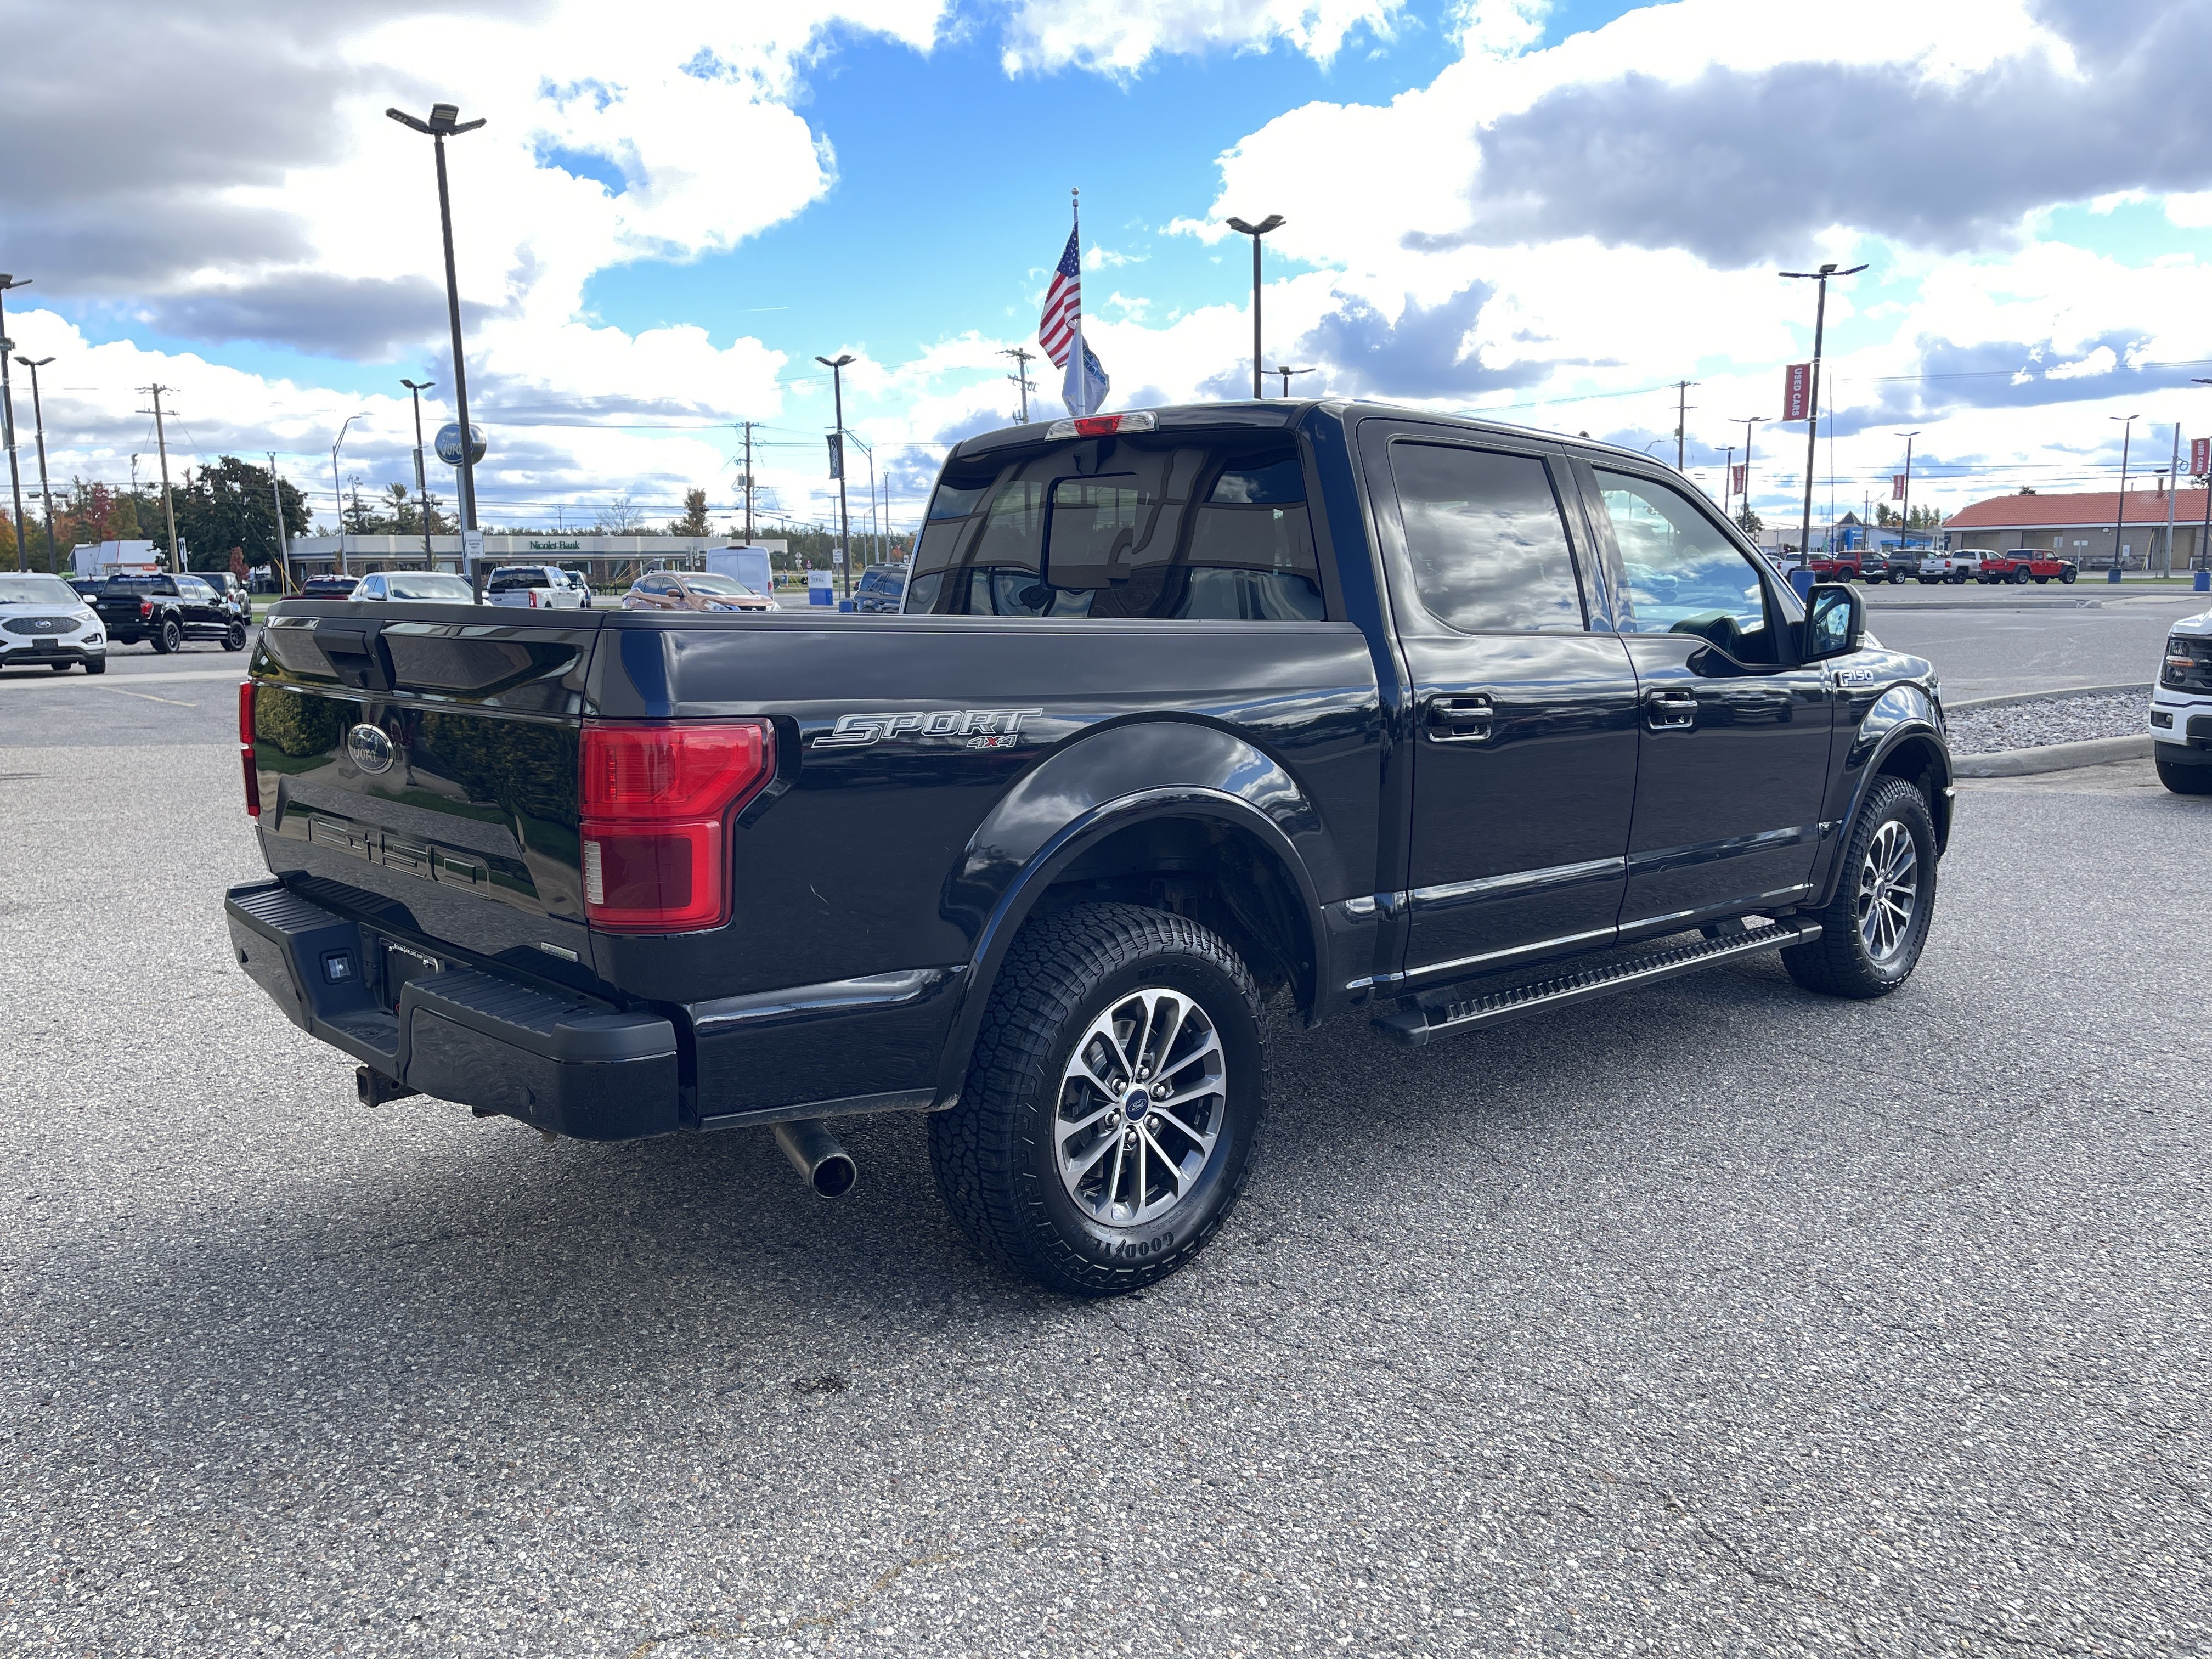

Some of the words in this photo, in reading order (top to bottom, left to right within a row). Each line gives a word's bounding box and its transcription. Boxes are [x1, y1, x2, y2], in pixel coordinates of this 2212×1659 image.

[1793, 368, 1802, 391] USED
[1791, 393, 1801, 416] CARS
[529, 540, 557, 549] Nicolet
[559, 540, 580, 549] Bank
[811, 708, 1043, 748] SPORT
[353, 734, 379, 764] Ford
[308, 812, 491, 900] F-150
[1131, 1101, 1144, 1111] Ford
